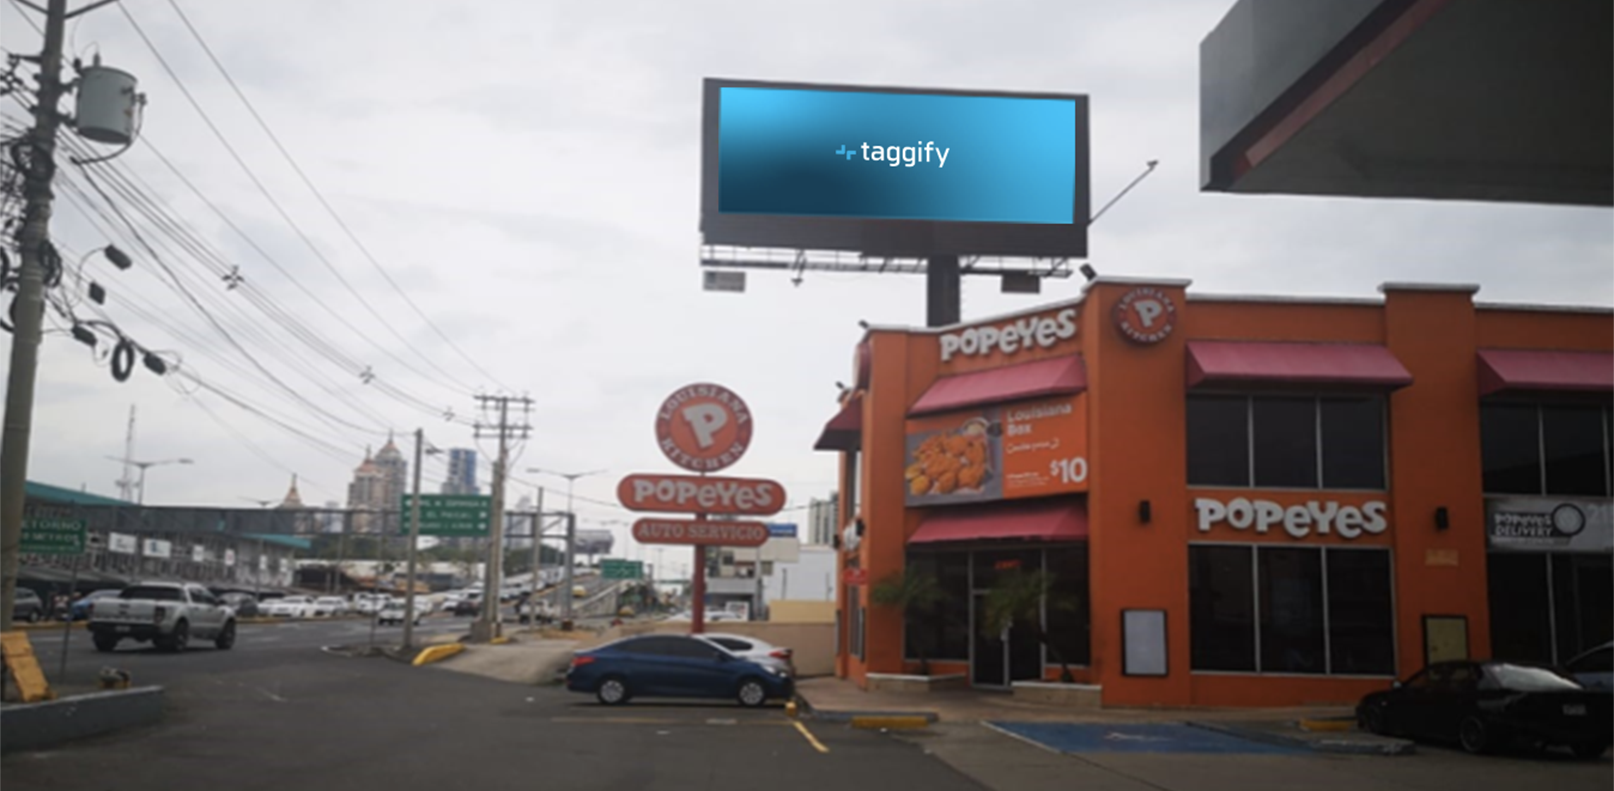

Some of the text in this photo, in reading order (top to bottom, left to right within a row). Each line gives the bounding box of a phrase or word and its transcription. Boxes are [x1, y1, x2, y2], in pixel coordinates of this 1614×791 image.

[861, 140, 950, 168] taggify
[1133, 299, 1163, 328] P
[660, 386, 749, 424] LOUISIANA
[1006, 403, 1073, 423] Louisiana
[681, 402, 728, 449] P
[1006, 423, 1032, 437] Box
[661, 437, 744, 469] KITCHEN
[637, 522, 684, 538] AUTO
[688, 524, 763, 541] SERVICIO
[1495, 526, 1553, 538] DELIVERY
